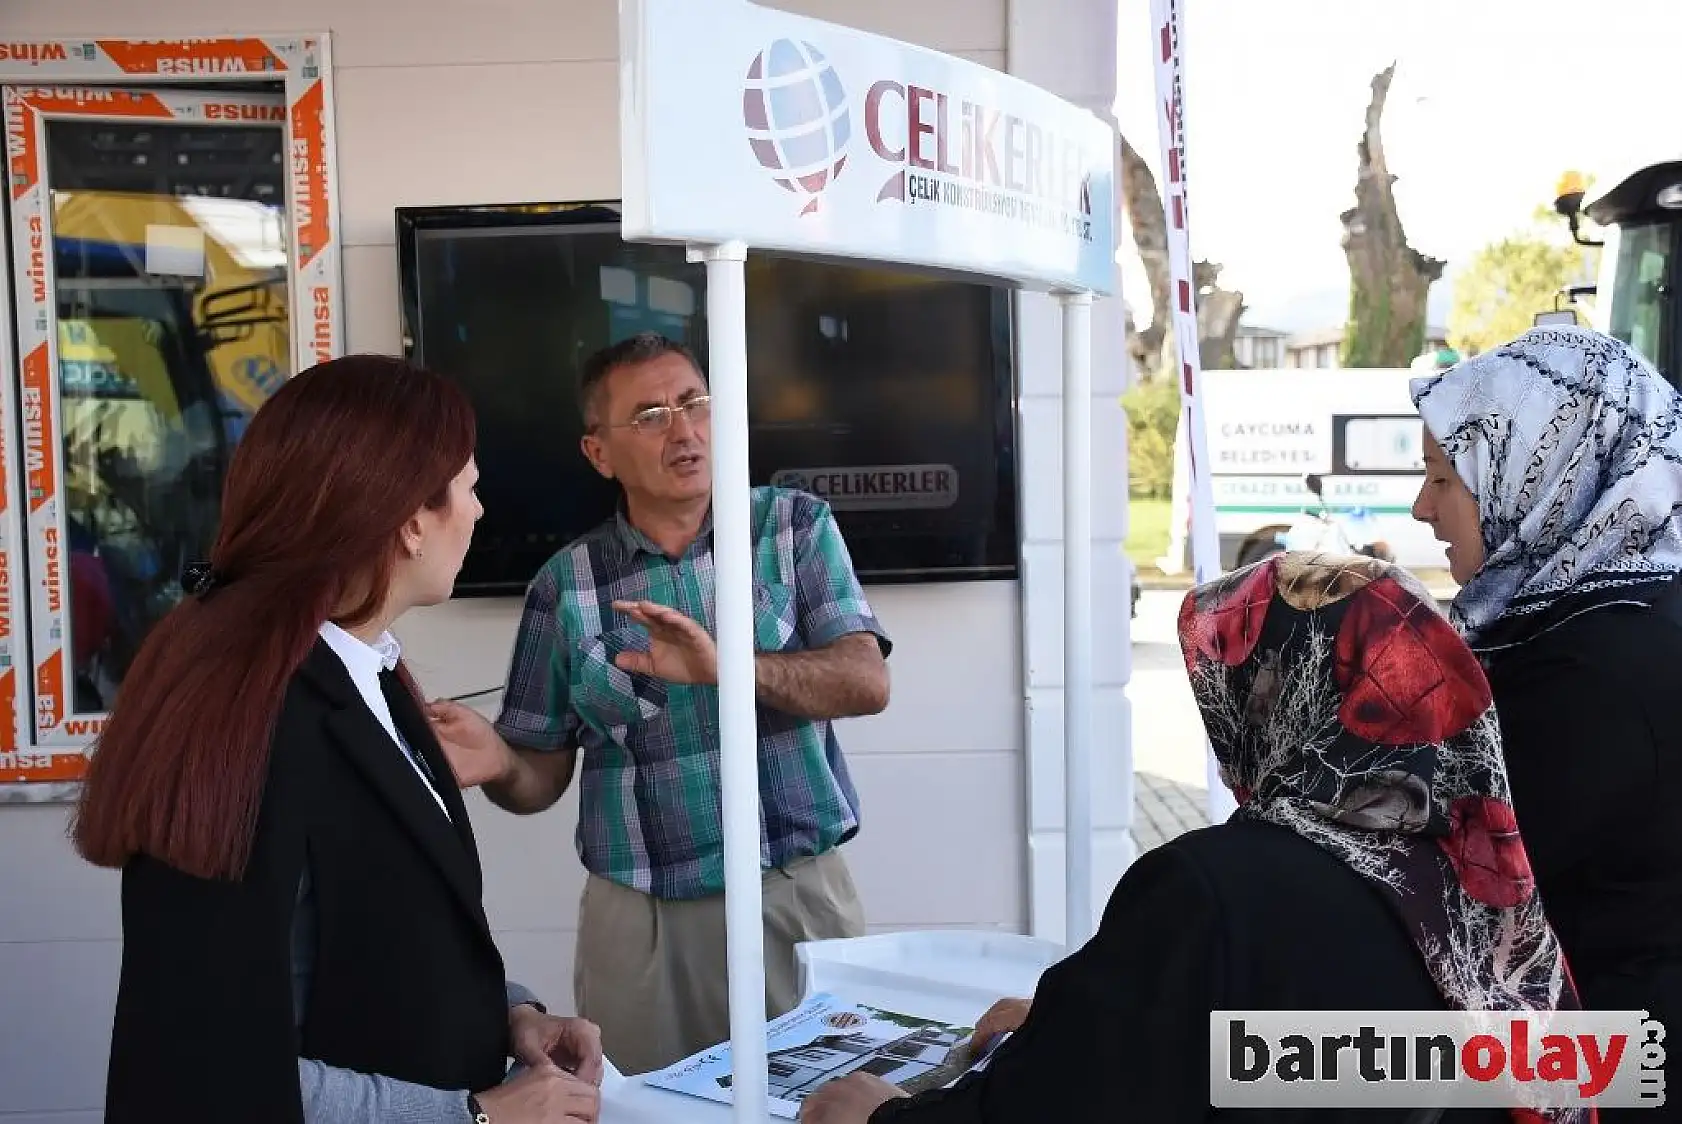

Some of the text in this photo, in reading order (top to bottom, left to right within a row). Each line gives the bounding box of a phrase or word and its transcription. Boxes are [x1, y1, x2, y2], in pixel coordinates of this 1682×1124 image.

[157, 58, 247, 74] winsa
[294, 138, 312, 224] winsa
[26, 215, 46, 303] winsa
[24, 388, 44, 471] winsa
[42, 527, 61, 613] winsa
